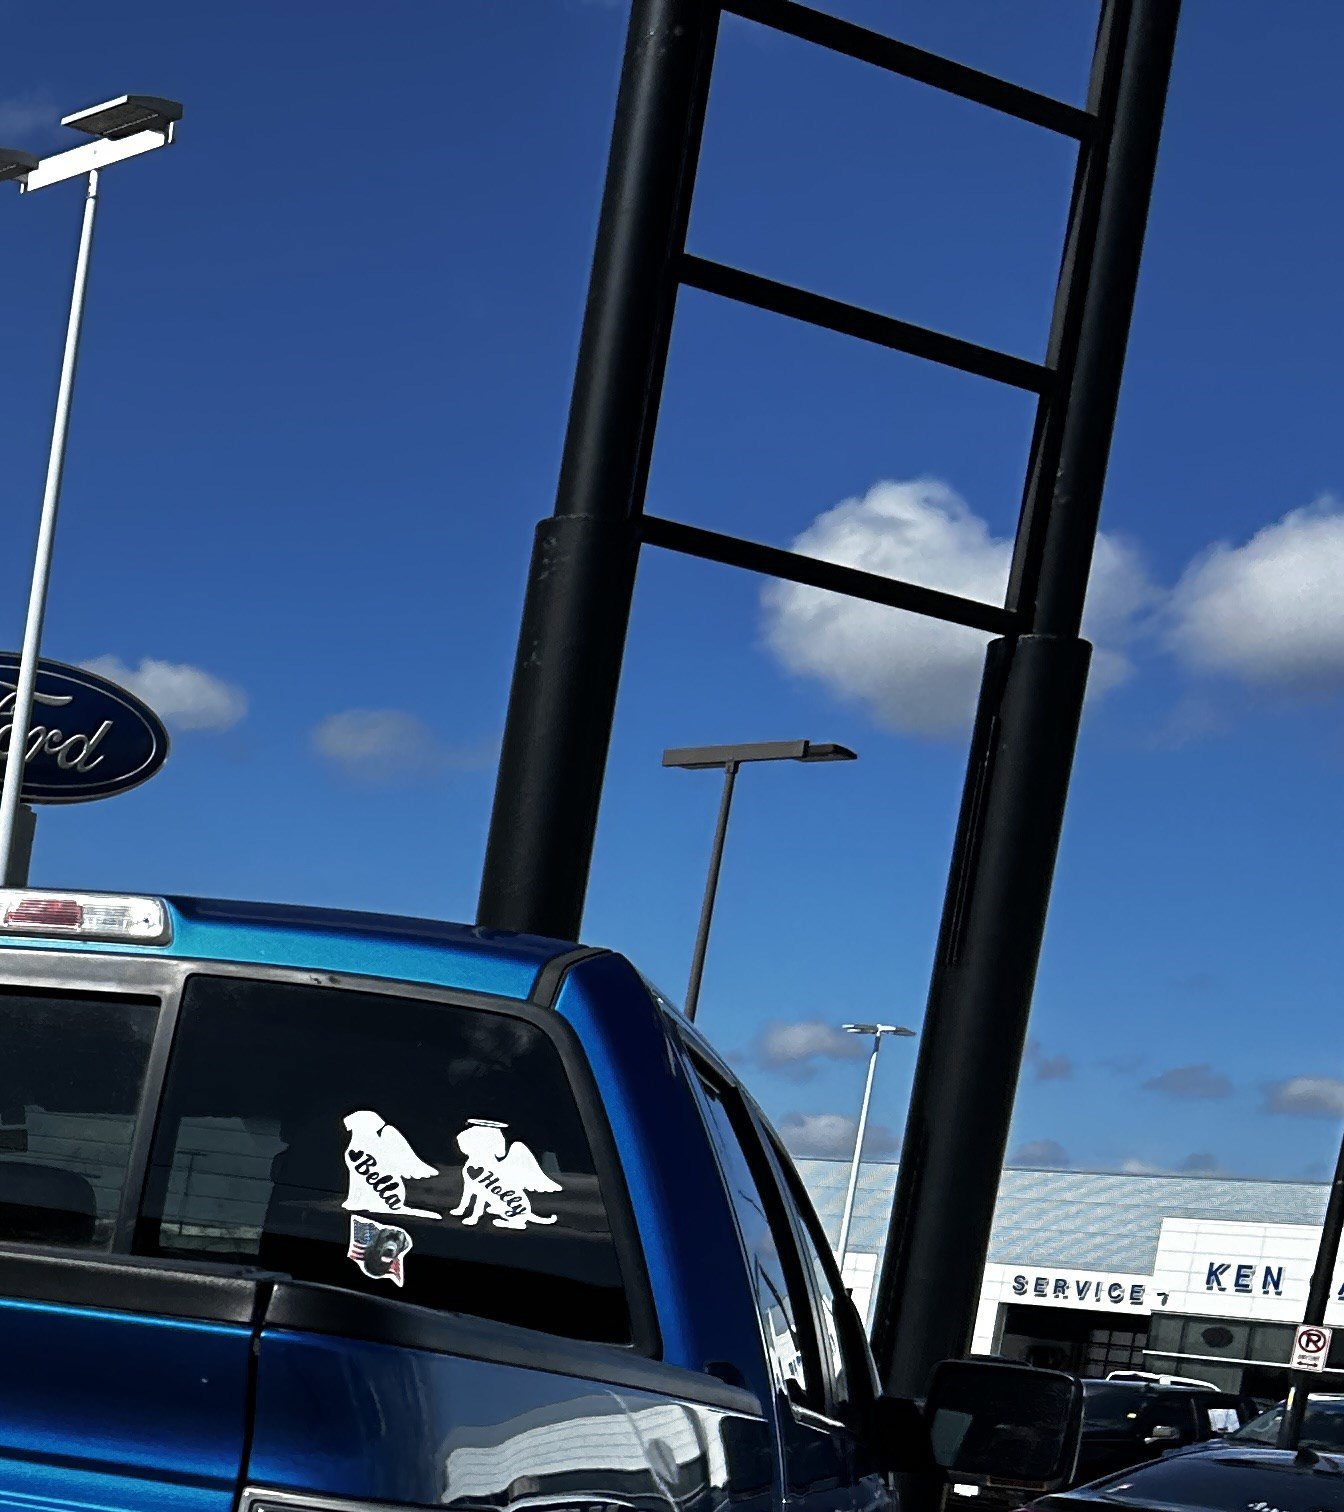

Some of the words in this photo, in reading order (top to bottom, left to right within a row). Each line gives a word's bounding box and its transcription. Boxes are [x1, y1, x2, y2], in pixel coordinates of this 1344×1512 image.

[355, 1153, 402, 1211] Bella
[478, 1170, 528, 1218] Holly
[1012, 1274, 1146, 1305] SERVICE
[1205, 1262, 1284, 1296] KEN
